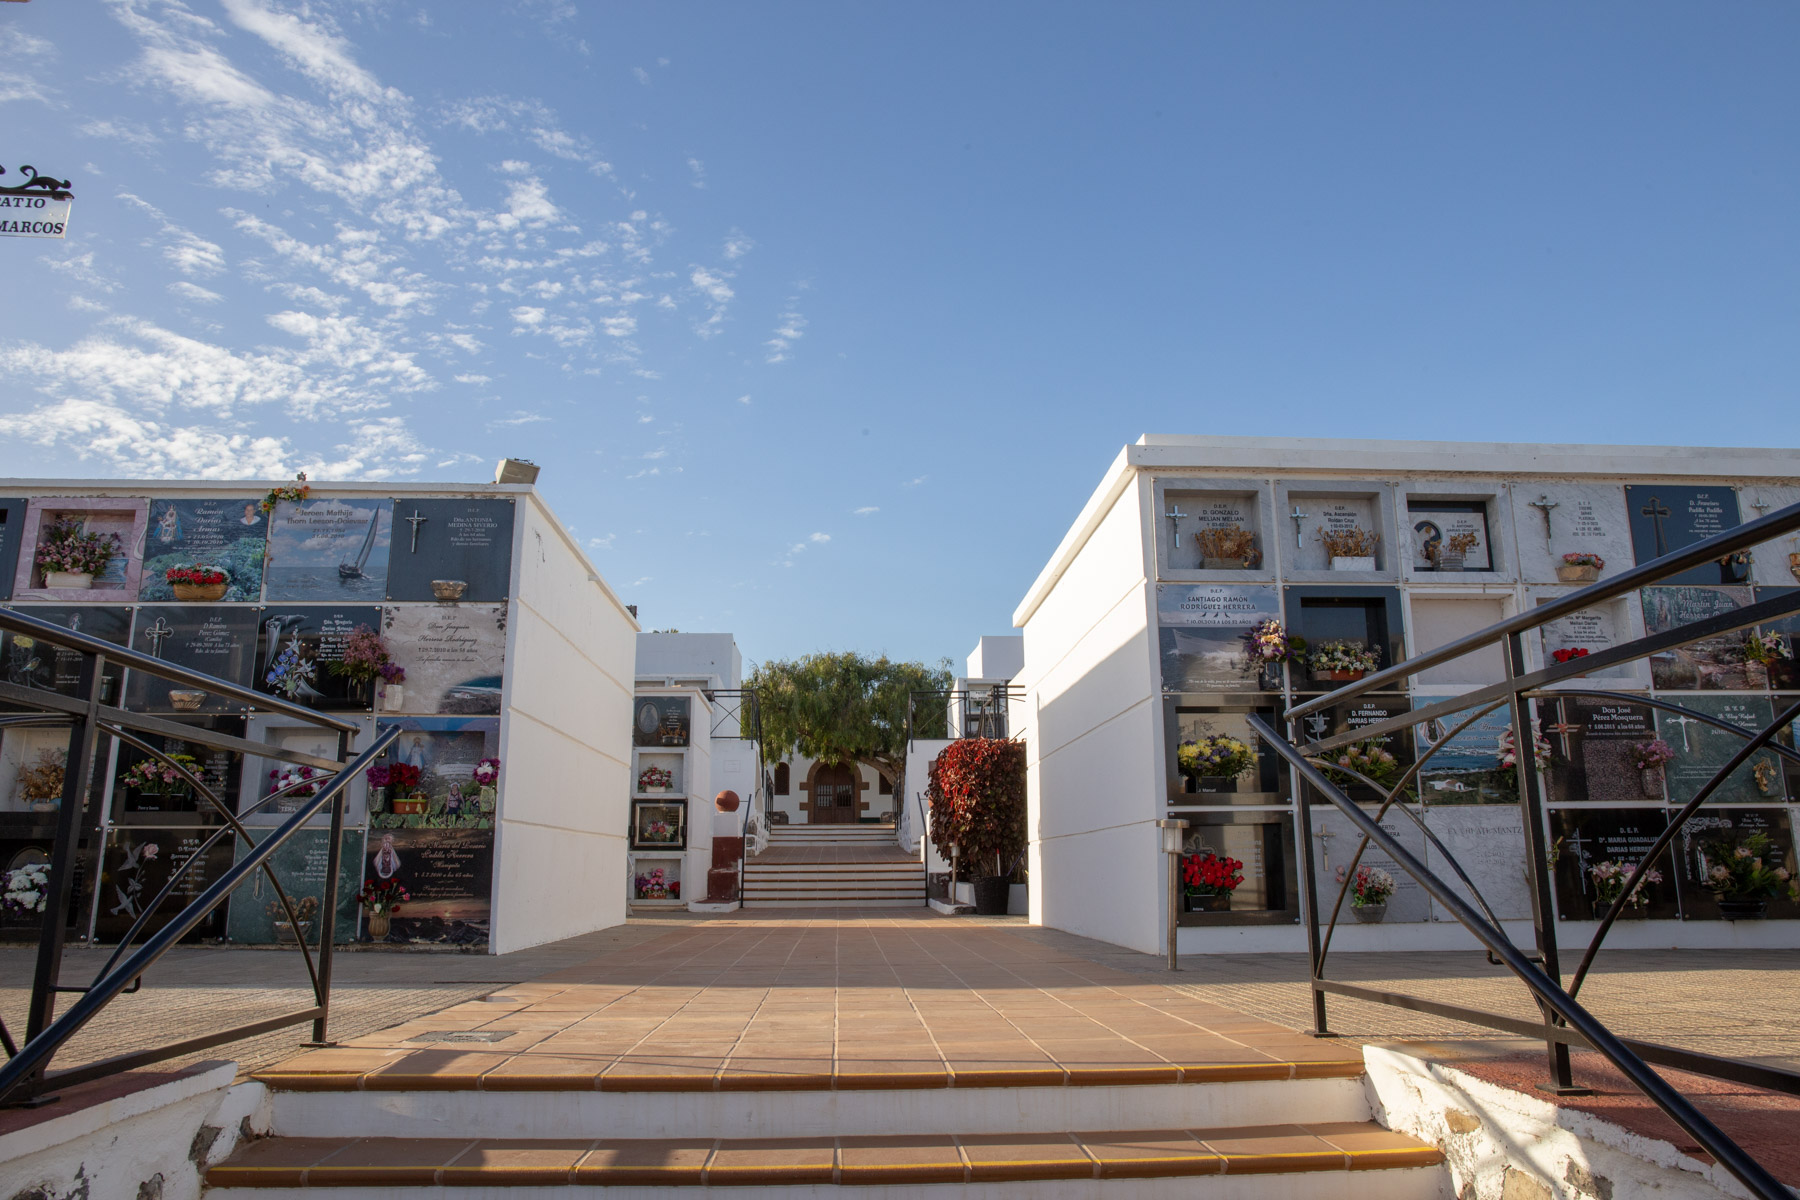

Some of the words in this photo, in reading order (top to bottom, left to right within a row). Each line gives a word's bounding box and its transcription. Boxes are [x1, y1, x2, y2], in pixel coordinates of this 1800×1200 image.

[0, 197, 46, 209] ATIO
[327, 509, 353, 518] Mathijs
[1223, 595, 1248, 603] RAMÓN
[1714, 600, 1733, 609] Juan
[1679, 610, 1710, 619] Herrera
[1617, 705, 1631, 714] José
[1592, 713, 1610, 721] Pérez
[1611, 714, 1644, 723] Mosquera
[1492, 826, 1522, 834] MANTZ
